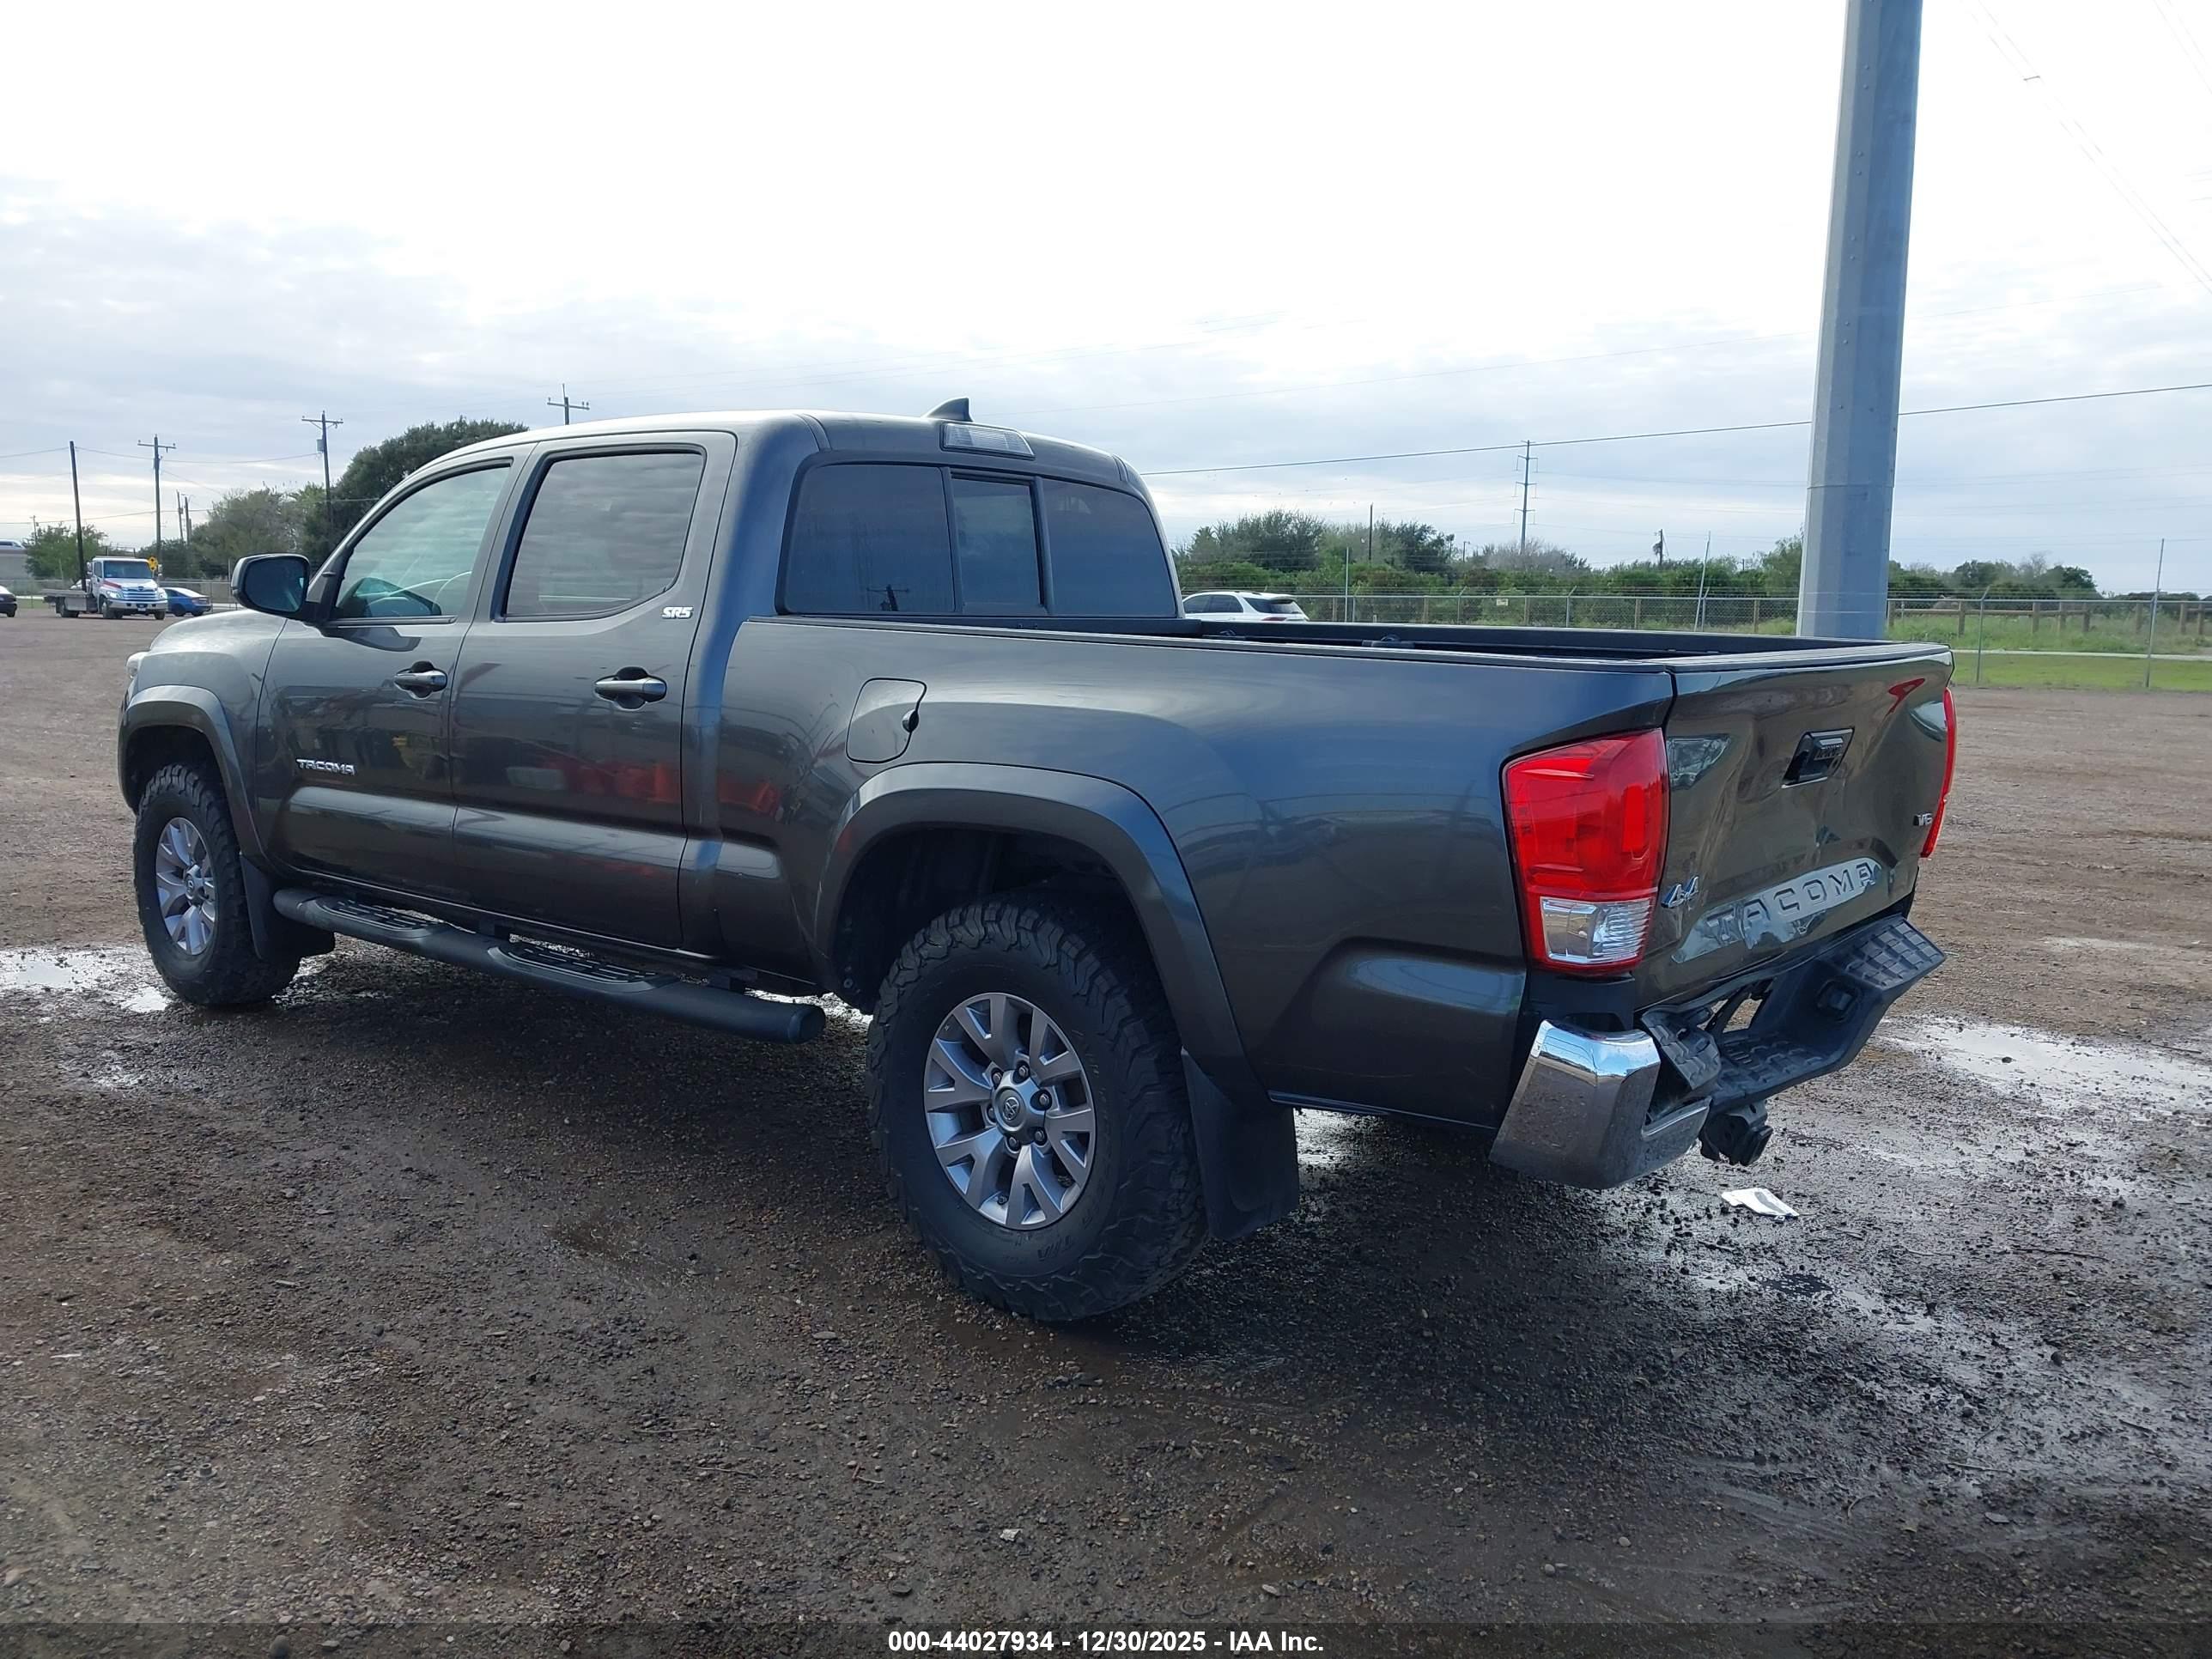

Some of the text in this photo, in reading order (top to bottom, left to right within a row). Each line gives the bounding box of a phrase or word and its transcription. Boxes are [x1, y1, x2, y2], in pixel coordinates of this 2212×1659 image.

[661, 606, 694, 619] SR5
[296, 758, 355, 775] TACOMA
[1916, 812, 1933, 826] V6
[1705, 861, 1877, 943] TACOMA
